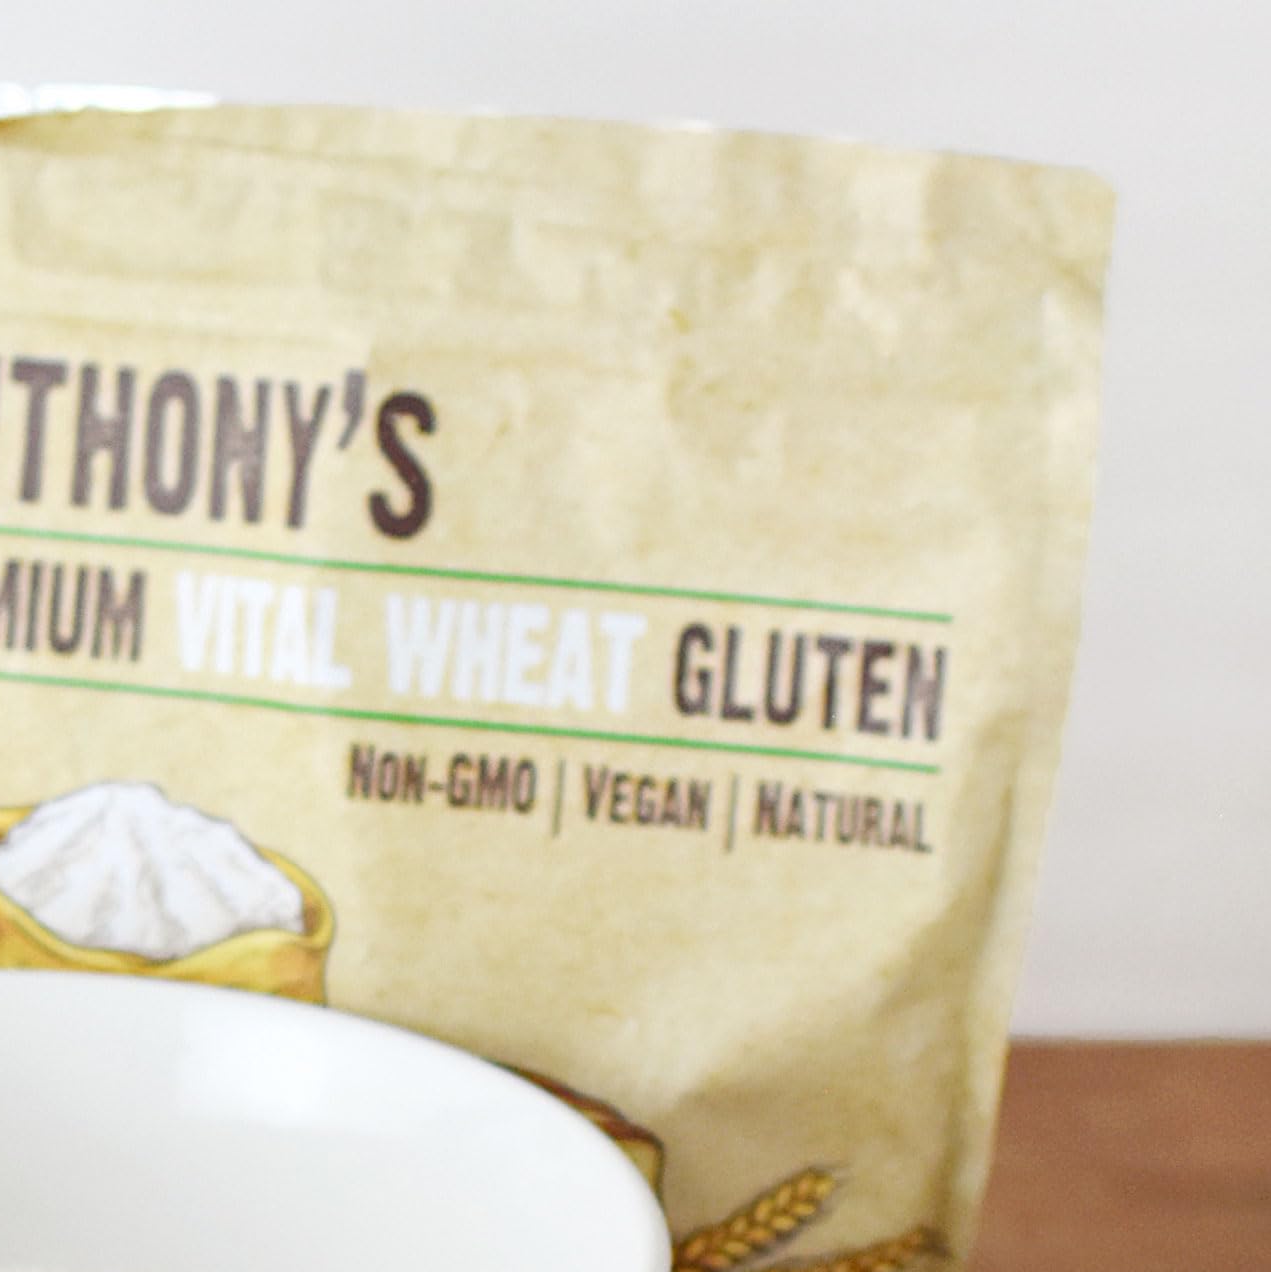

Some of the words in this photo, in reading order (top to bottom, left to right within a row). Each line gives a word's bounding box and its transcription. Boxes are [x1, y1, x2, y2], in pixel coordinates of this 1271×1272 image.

[174, 570, 353, 690] VITAL
[383, 591, 648, 713] WHEAT
[673, 621, 948, 741] GLUTEN
